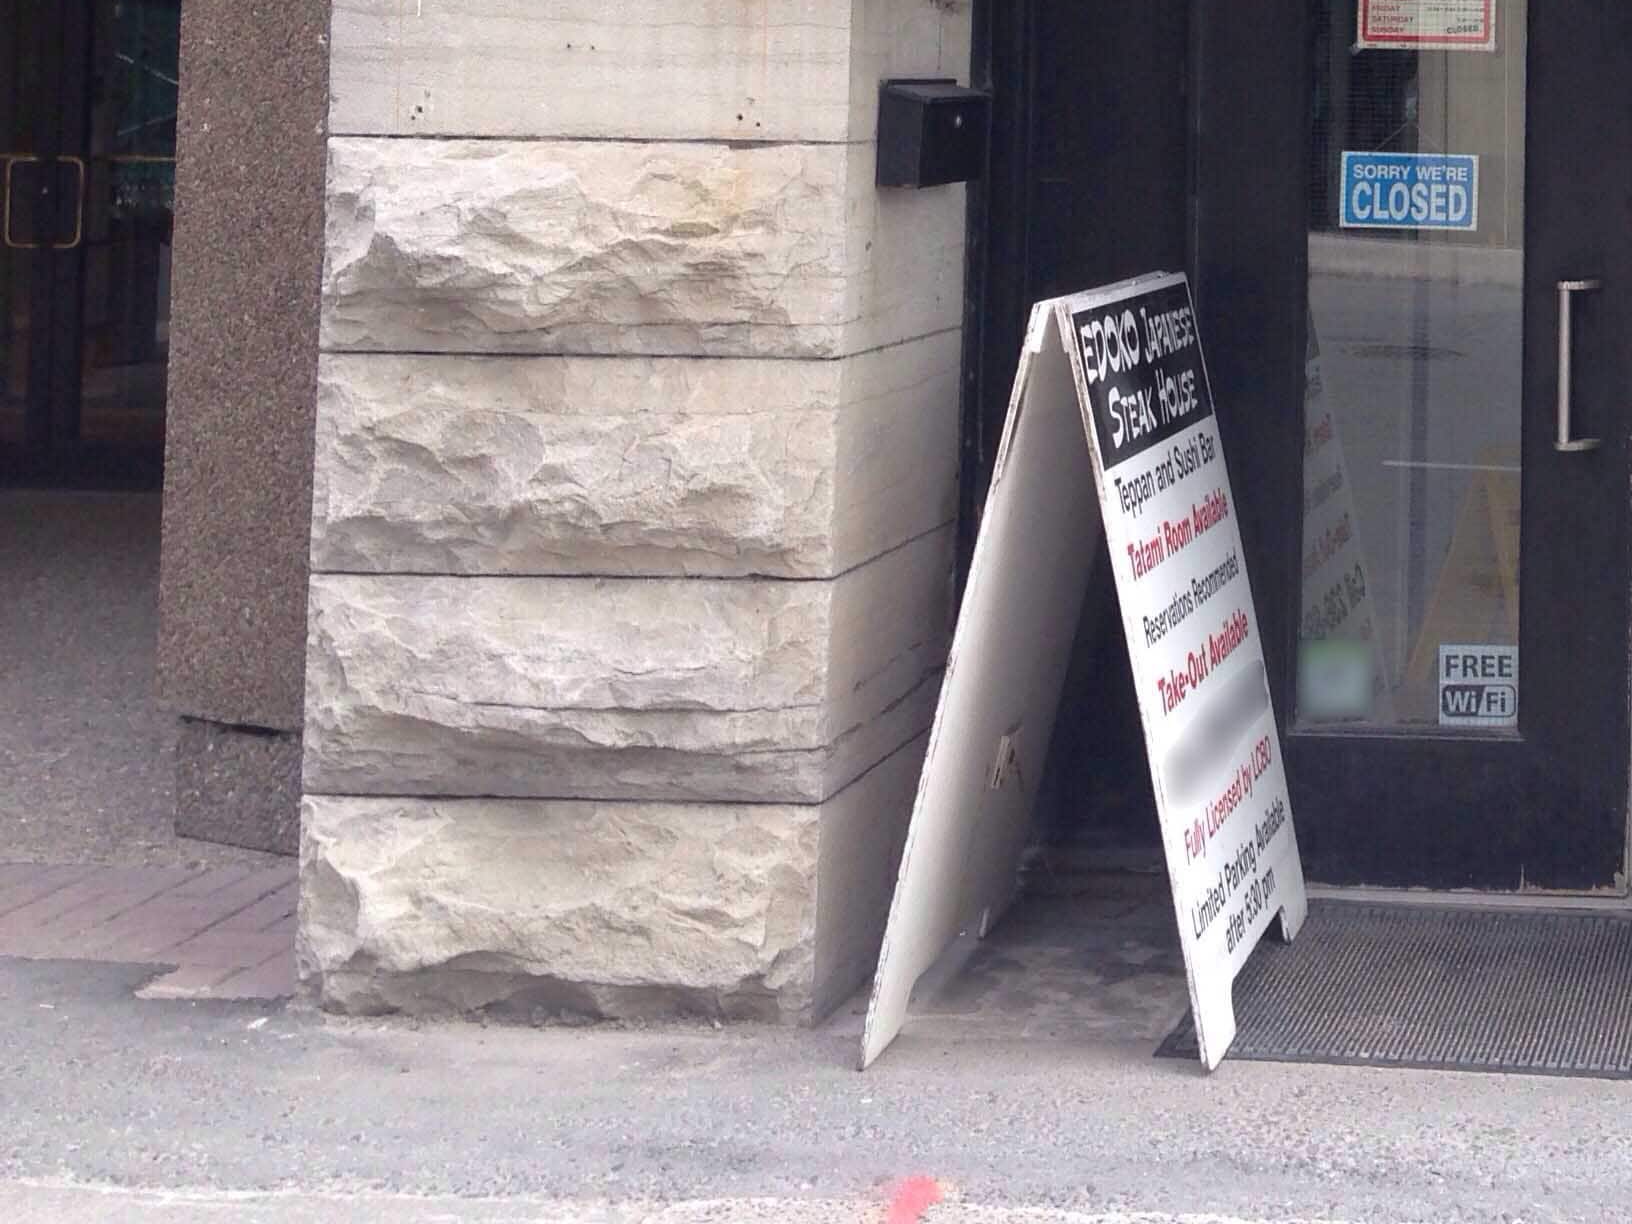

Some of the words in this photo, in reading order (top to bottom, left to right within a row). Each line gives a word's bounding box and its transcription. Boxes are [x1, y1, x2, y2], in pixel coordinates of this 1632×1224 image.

[1446, 24, 1480, 34] CLOSED
[1351, 181, 1468, 222] CLOSED
[1352, 164, 1410, 180] SORRY
[1416, 164, 1468, 182] WE'RE
[1080, 309, 1140, 385] EDOKO
[1140, 307, 1195, 364] JAPANESE
[1108, 386, 1158, 449] STEAK
[1155, 368, 1198, 425] HOUSE
[1114, 471, 1156, 518] Teppan
[1155, 450, 1175, 492] and
[1173, 437, 1201, 480] Sushi
[1198, 432, 1216, 464] Bar
[1127, 527, 1165, 581] Tatami
[1163, 517, 1193, 557] Room
[1192, 487, 1229, 538] Available
[1142, 589, 1194, 648] Reservations
[1191, 547, 1240, 609] Recommended
[1157, 643, 1209, 716] Take-Out
[1208, 608, 1249, 671] Available
[1445, 655, 1513, 678] FREE
[1184, 818, 1206, 865] Fully
[1205, 770, 1243, 838] Licensed
[1240, 764, 1253, 799] by
[1191, 871, 1226, 939] Limited
[1224, 840, 1257, 896] Parking
[1255, 796, 1285, 857] Available
[1226, 908, 1246, 954] after
[1244, 878, 1262, 924] 5:30
[1261, 866, 1276, 910] pm
